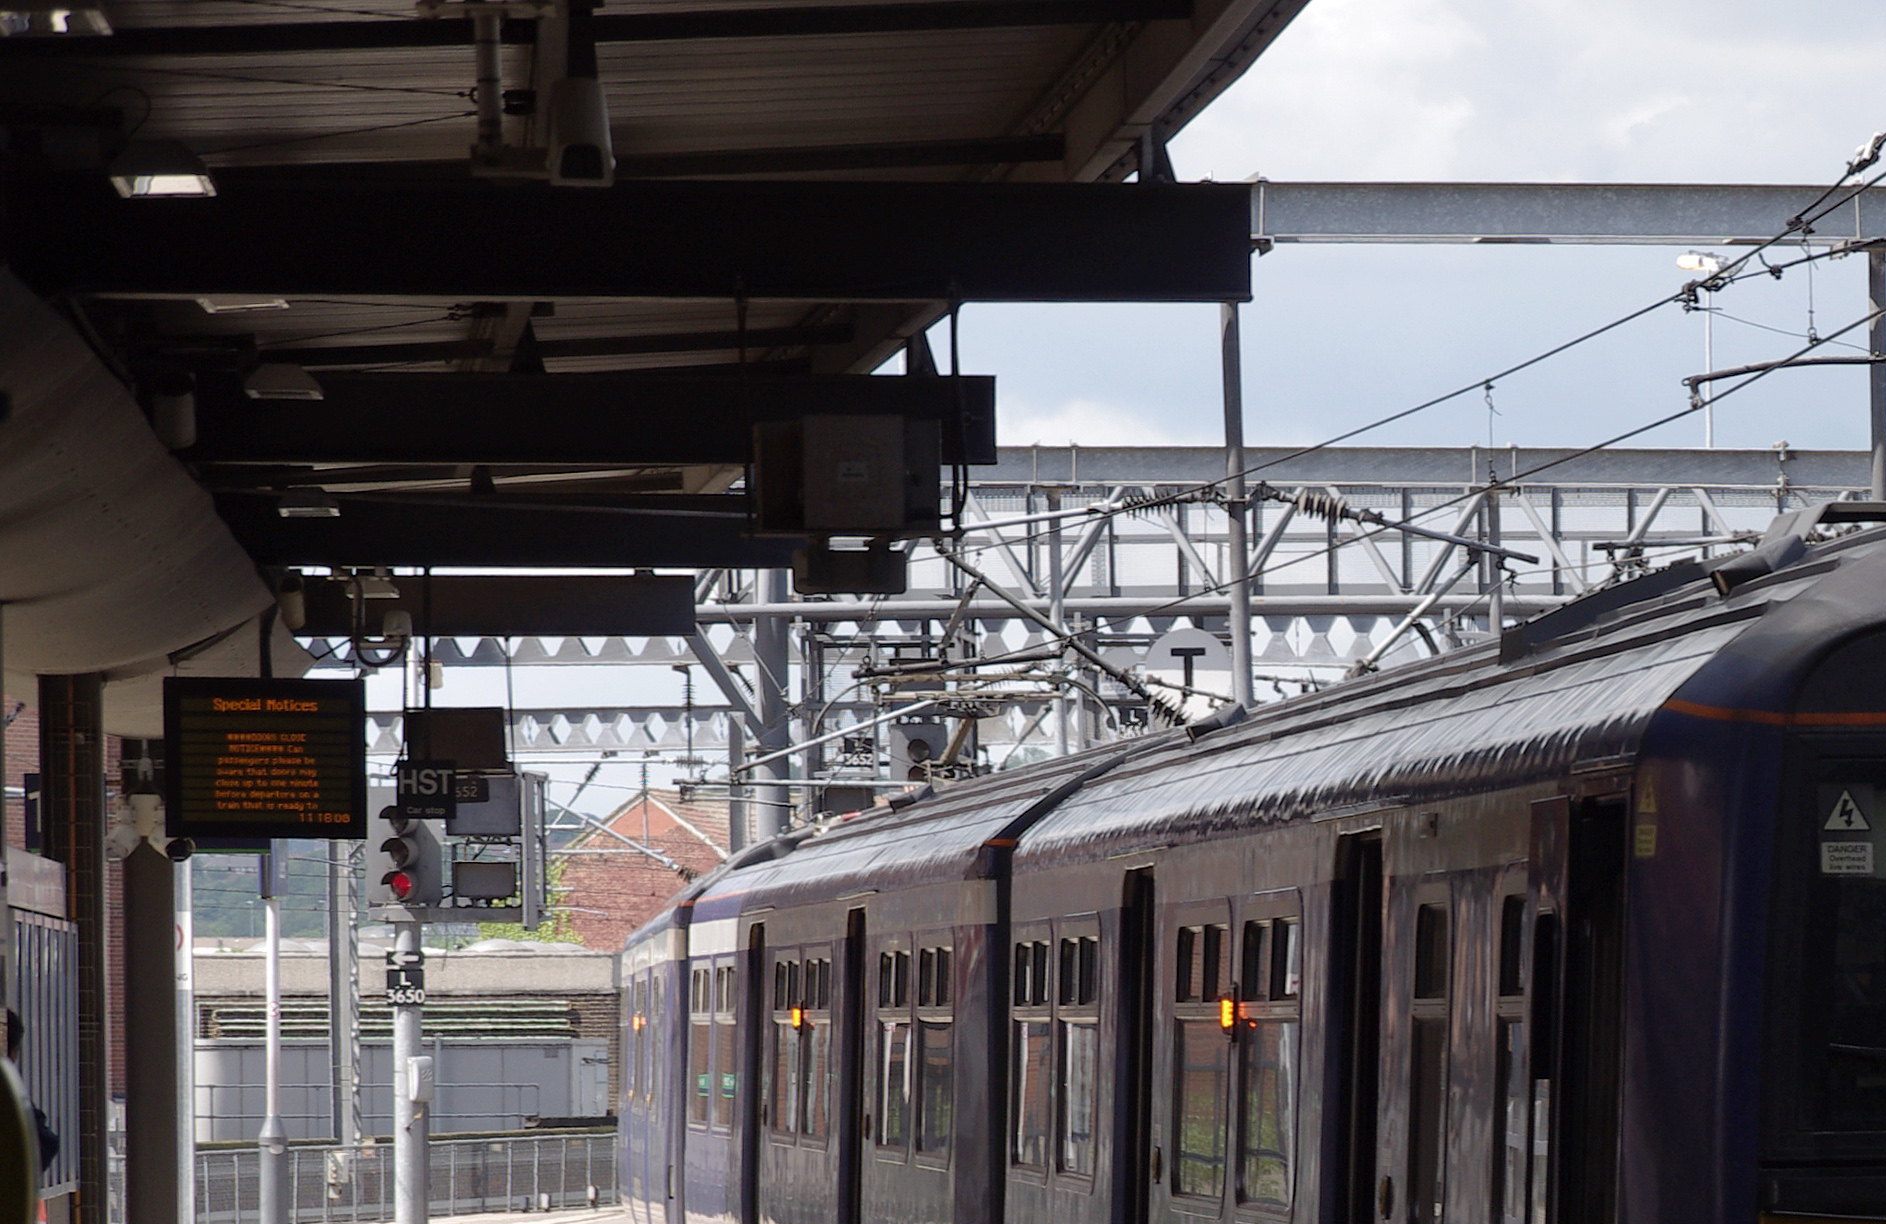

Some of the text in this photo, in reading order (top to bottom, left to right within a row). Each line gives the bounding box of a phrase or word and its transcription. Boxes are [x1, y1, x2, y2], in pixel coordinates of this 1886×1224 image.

[1172, 648, 1205, 689] T
[212, 698, 319, 712] Special Notices
[272, 756, 303, 767] please
[844, 754, 873, 766] 3652
[246, 767, 268, 776] that
[270, 767, 297, 776] doors
[299, 768, 317, 778] may
[215, 778, 319, 788] close up to one minute
[399, 768, 454, 796] HST
[215, 790, 246, 798] before
[250, 789, 296, 800] departure
[217, 800, 241, 809] train
[243, 800, 265, 809] that
[278, 801, 305, 811] ready
[306, 800, 318, 809] to
[406, 806, 447, 817] Car stop
[1828, 845, 1867, 854] DANGER
[1829, 854, 1867, 862] Overhead
[400, 971, 412, 987] L
[386, 987, 425, 1005] 3650
